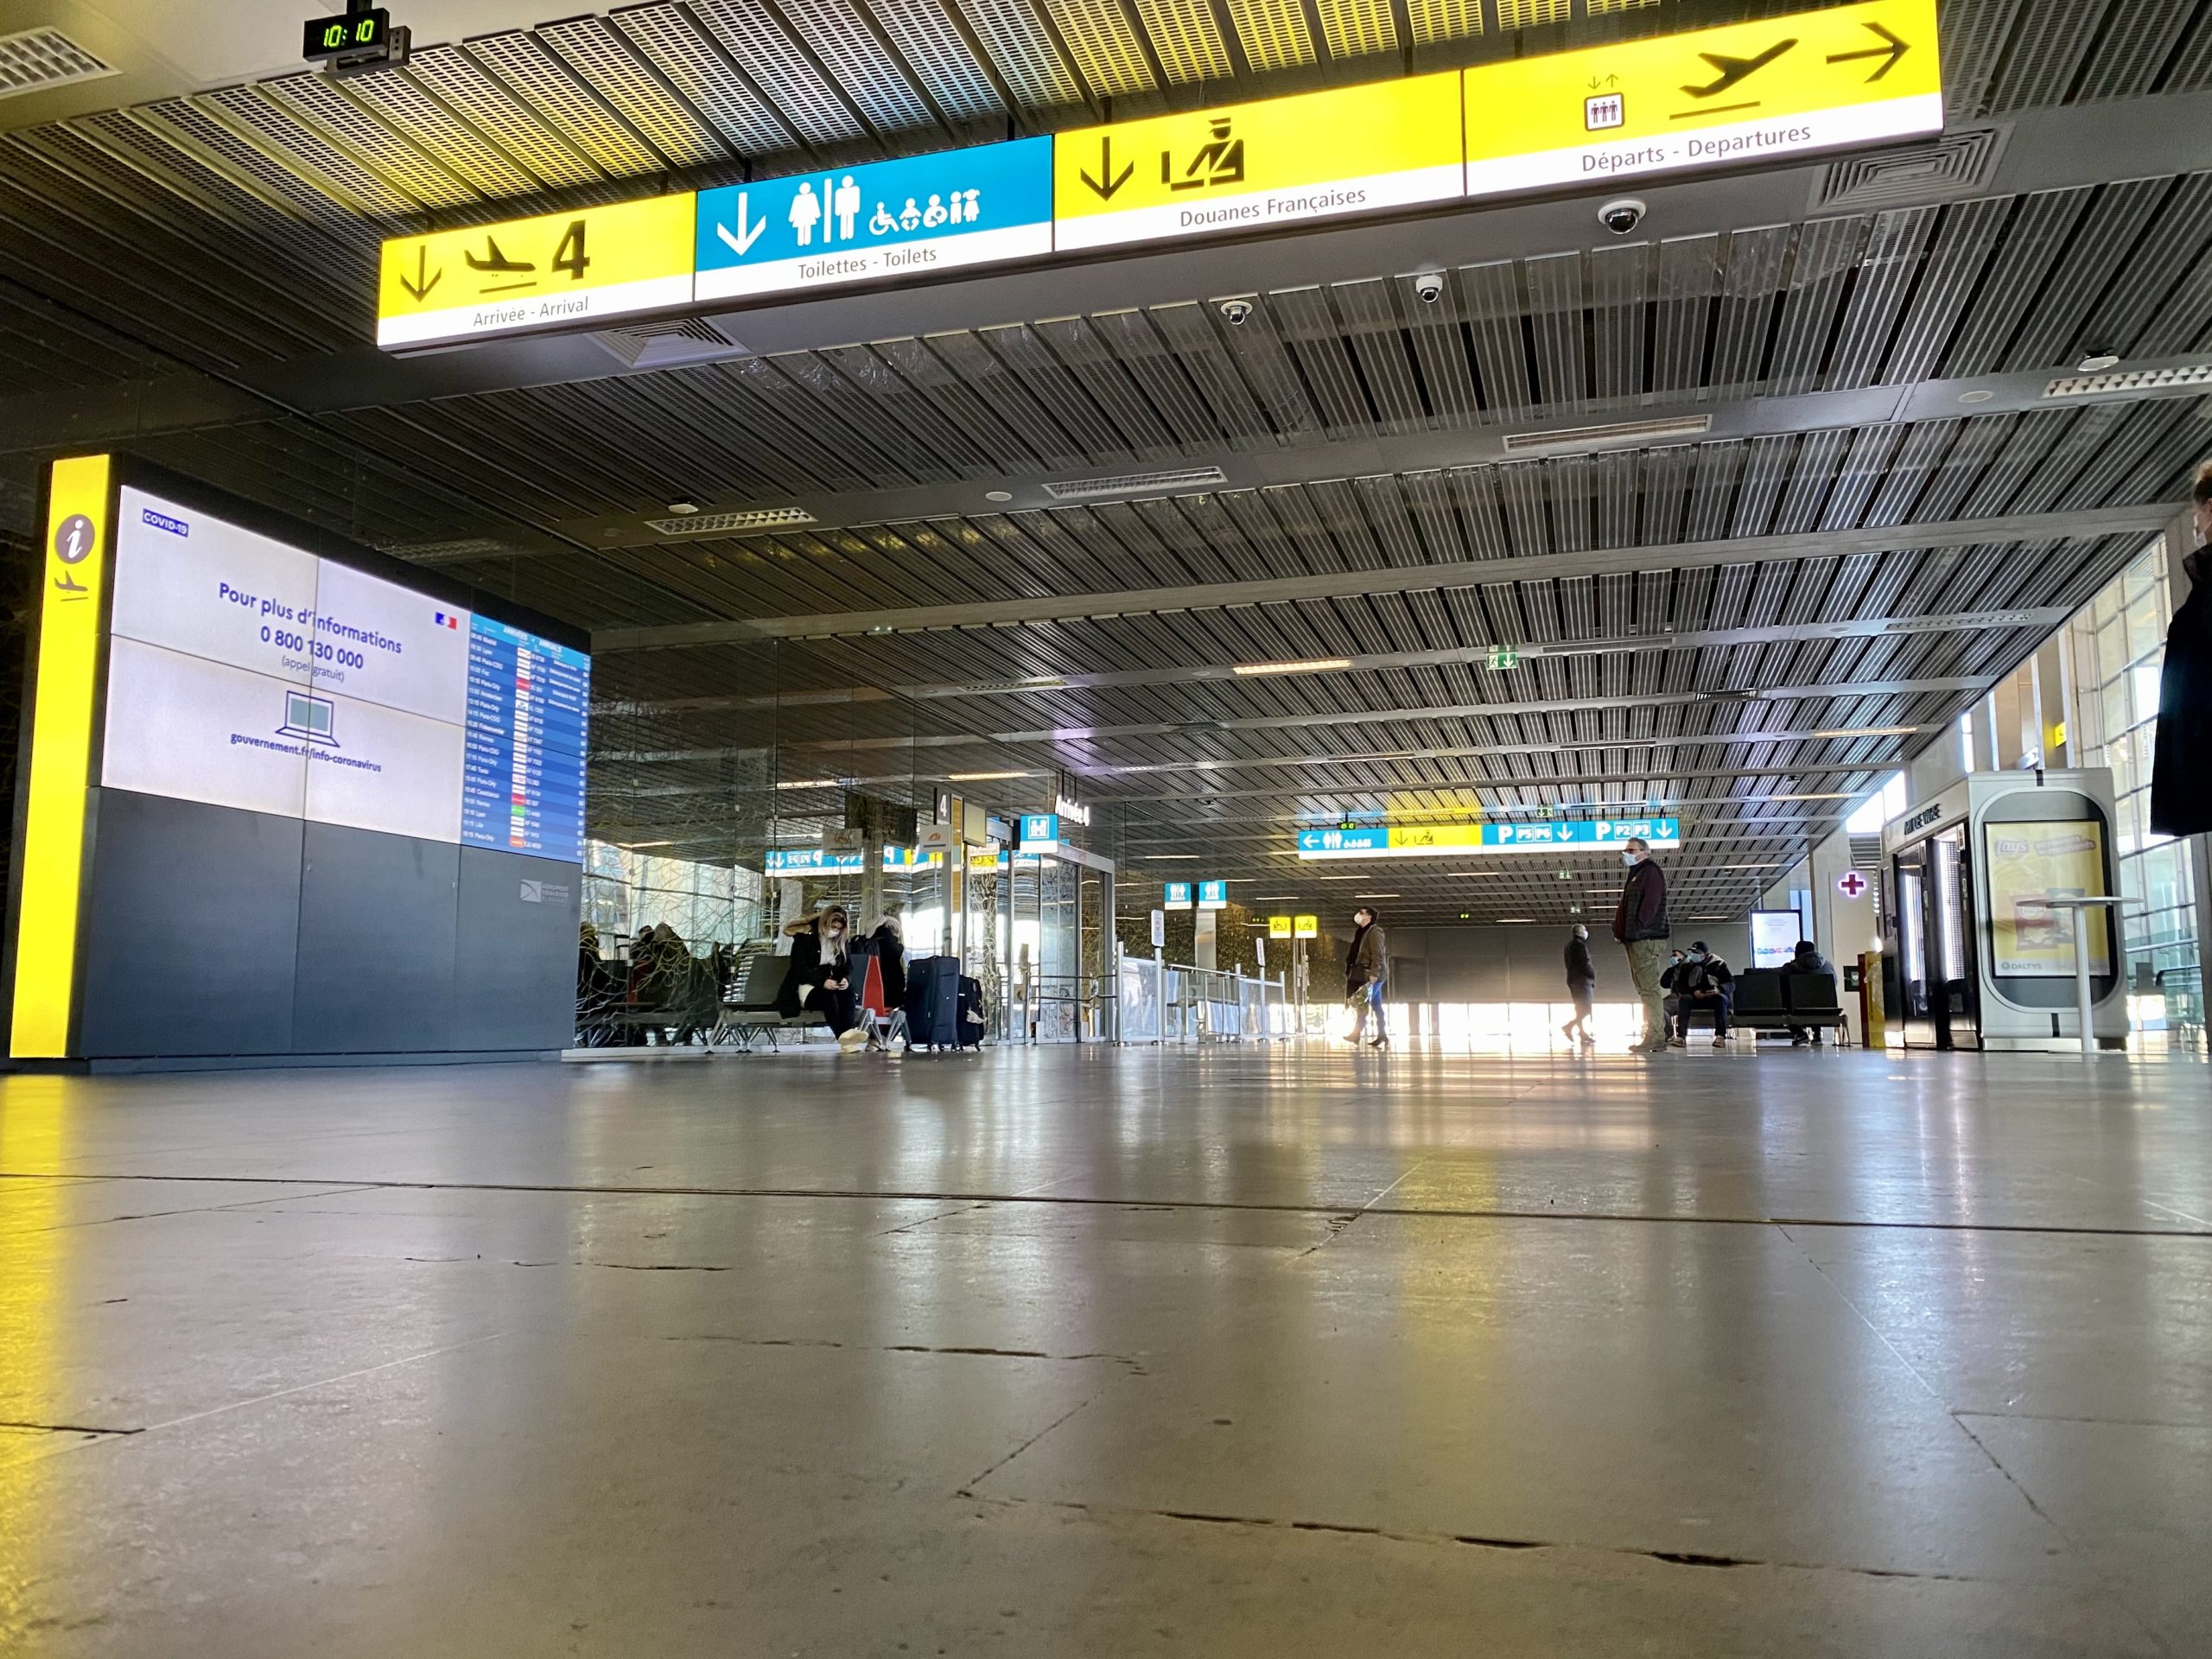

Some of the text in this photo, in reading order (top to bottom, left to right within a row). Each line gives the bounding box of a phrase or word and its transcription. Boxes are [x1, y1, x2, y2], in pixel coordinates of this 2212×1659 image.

[1582, 146, 1664, 172] Départs
[1688, 126, 1811, 157] Departures
[1180, 189, 1366, 226] Douanes Françaises
[551, 219, 590, 280] 4
[798, 258, 867, 279] Toilettes
[884, 247, 937, 267] Toilets
[474, 307, 525, 327] Arrivée
[539, 296, 588, 318] Arrival
[143, 512, 188, 535] COVID-19
[219, 582, 402, 654] Pour plus d'informations
[260, 626, 364, 670] 0 800 130 000
[282, 655, 345, 683] (appel gratuit)
[940, 794, 948, 817] 4
[1498, 825, 1513, 843] P
[1596, 822, 1611, 841] P
